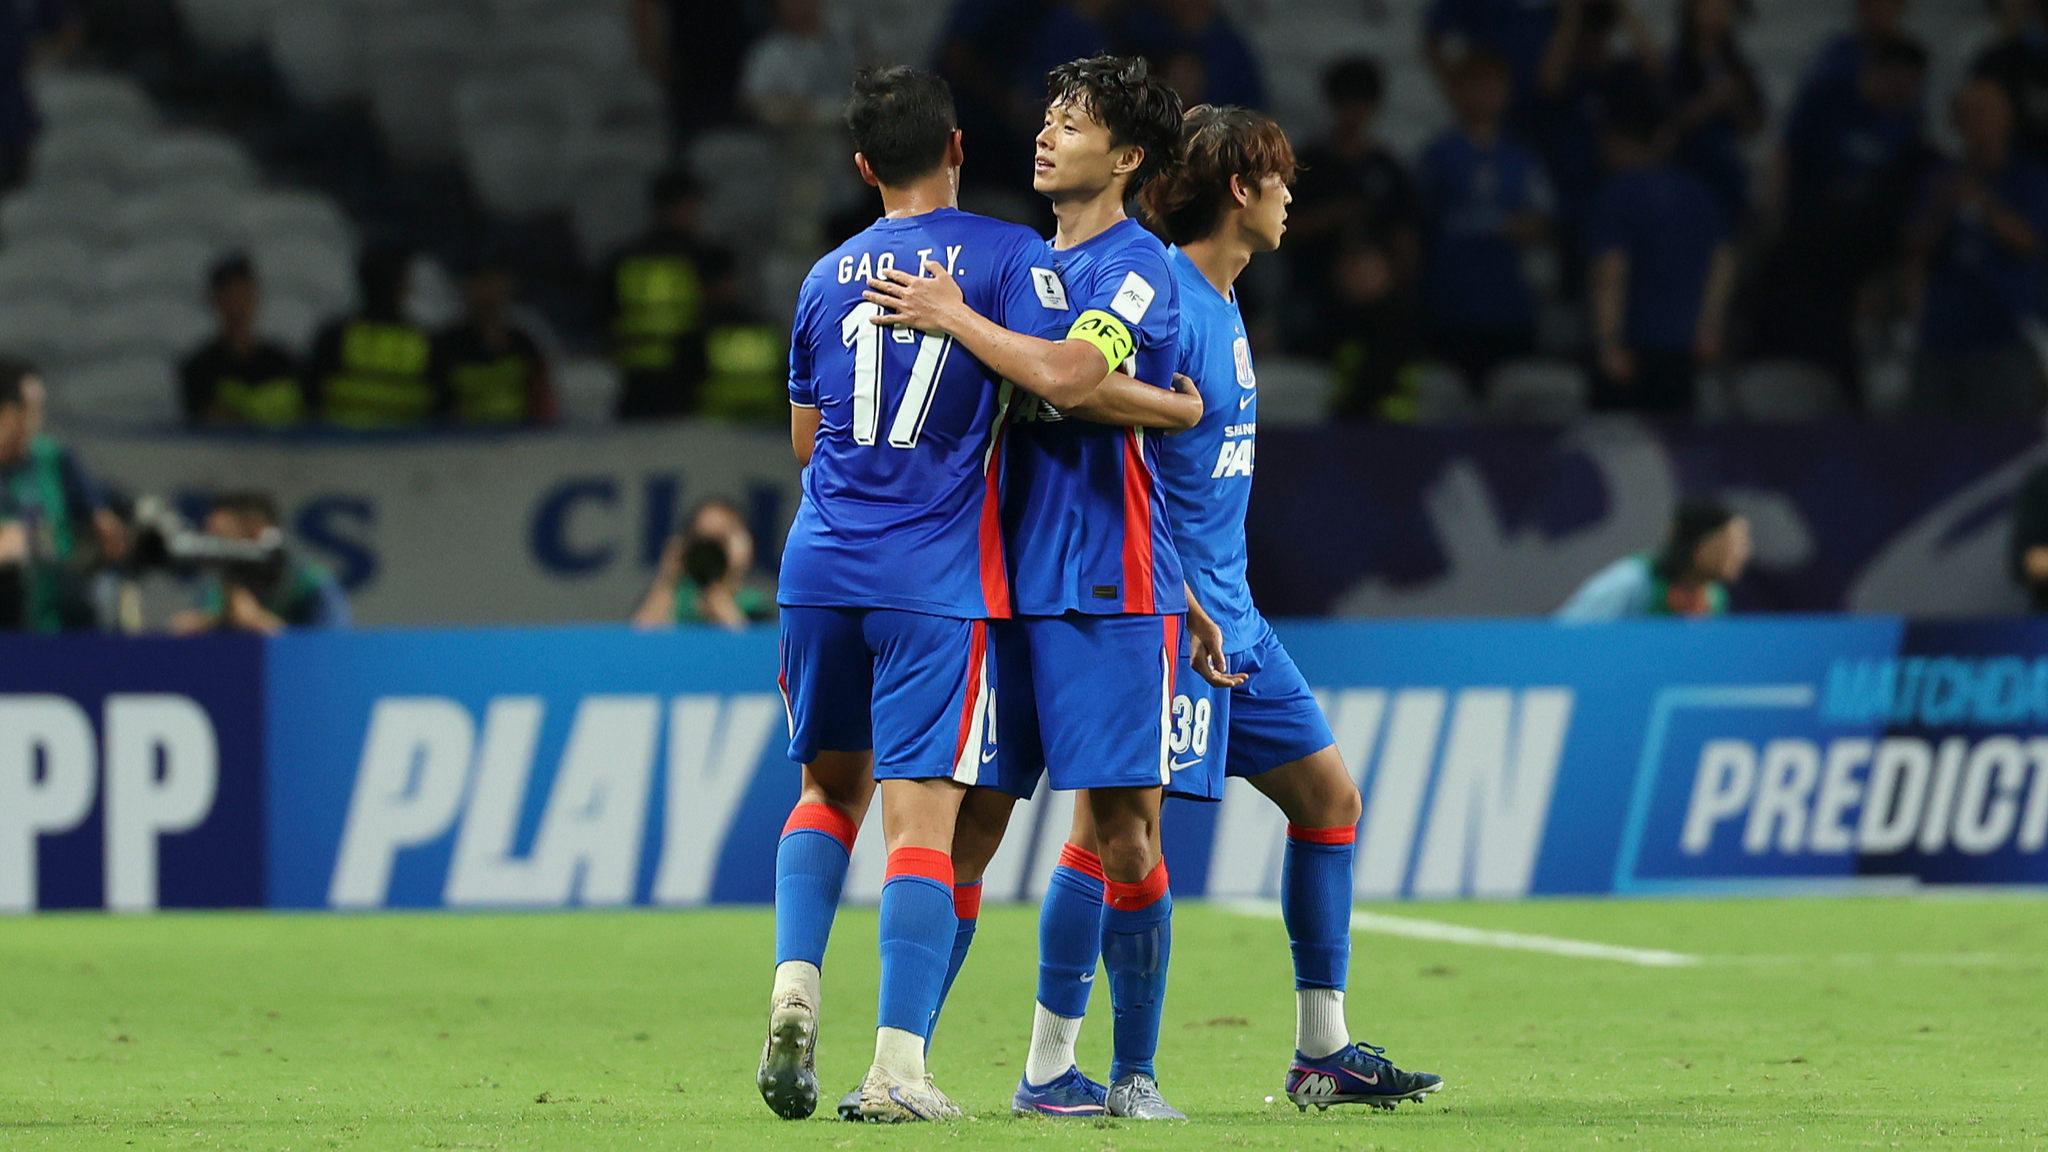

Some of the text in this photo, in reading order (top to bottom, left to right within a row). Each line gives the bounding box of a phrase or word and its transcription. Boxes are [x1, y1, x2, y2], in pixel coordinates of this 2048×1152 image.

[838, 252, 895, 284] GAO
[1123, 289, 1145, 308] AFC
[1072, 318, 1127, 359] AFC
[841, 301, 954, 449] 17
[1211, 438, 1256, 479] PA
[1169, 694, 1211, 757] 38
[326, 695, 783, 906] PLAY
